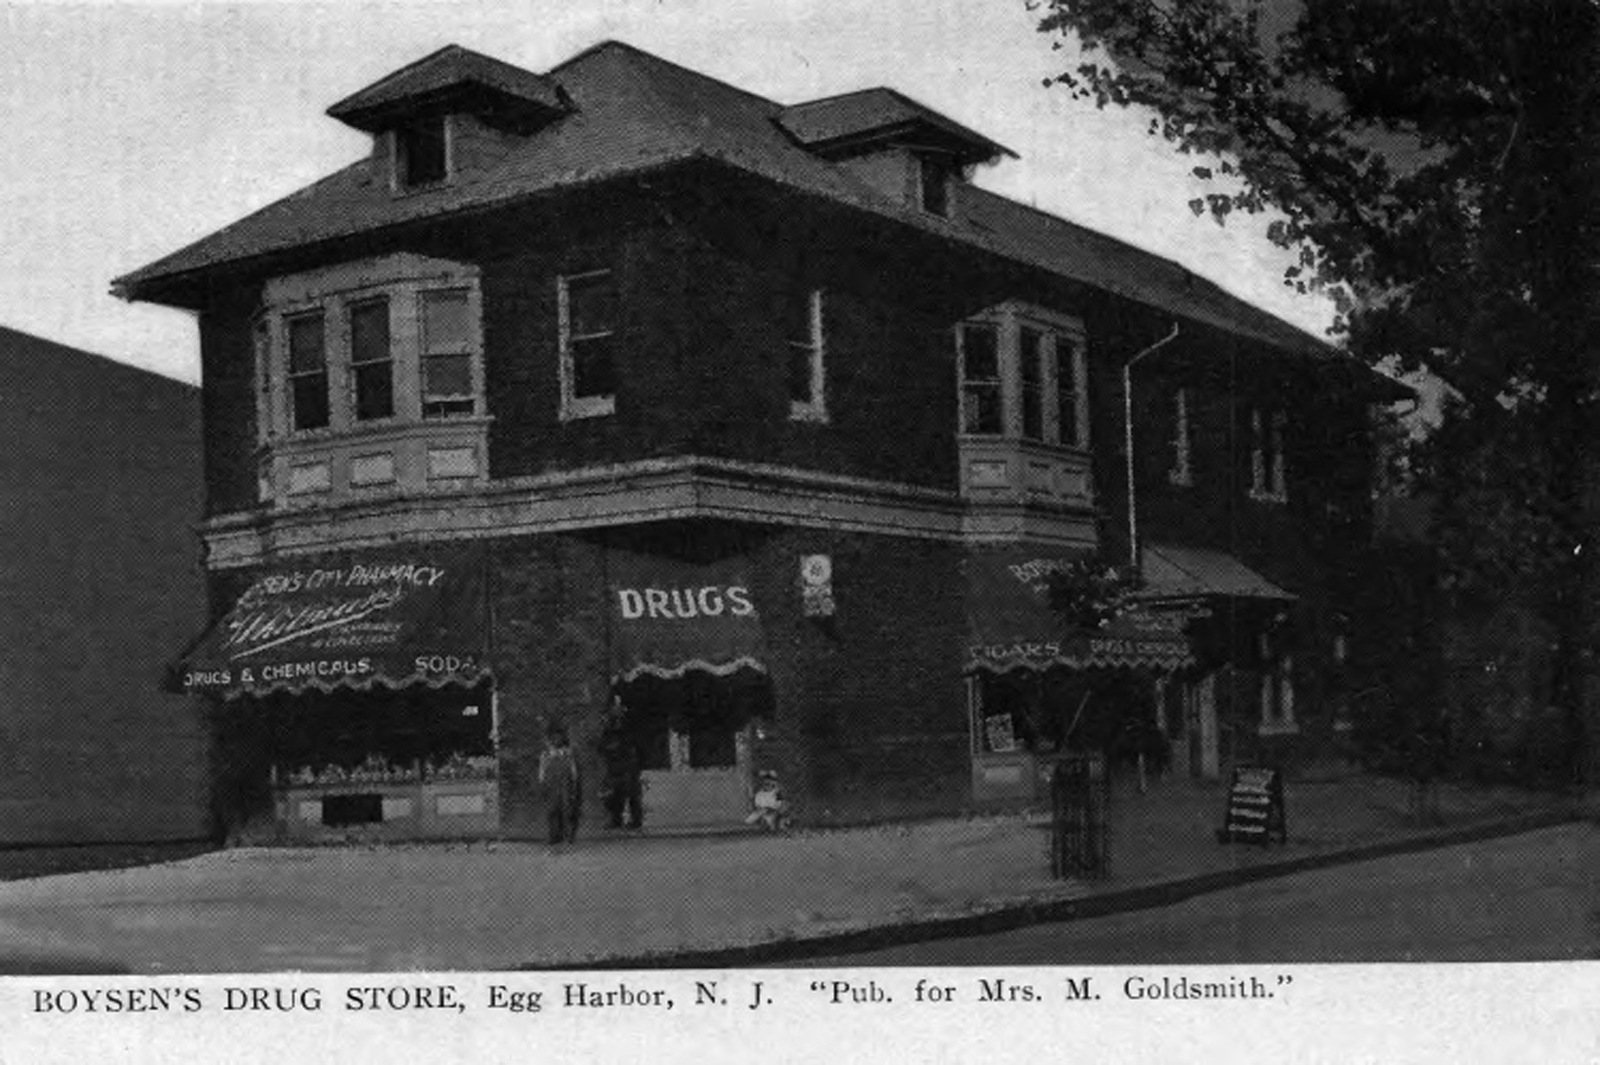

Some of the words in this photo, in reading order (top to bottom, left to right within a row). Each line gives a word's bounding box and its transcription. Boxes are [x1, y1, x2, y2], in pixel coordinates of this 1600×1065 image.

[345, 564, 445, 588] PHARMACY
[618, 586, 754, 618] DRUGS
[241, 666, 255, 682] &
